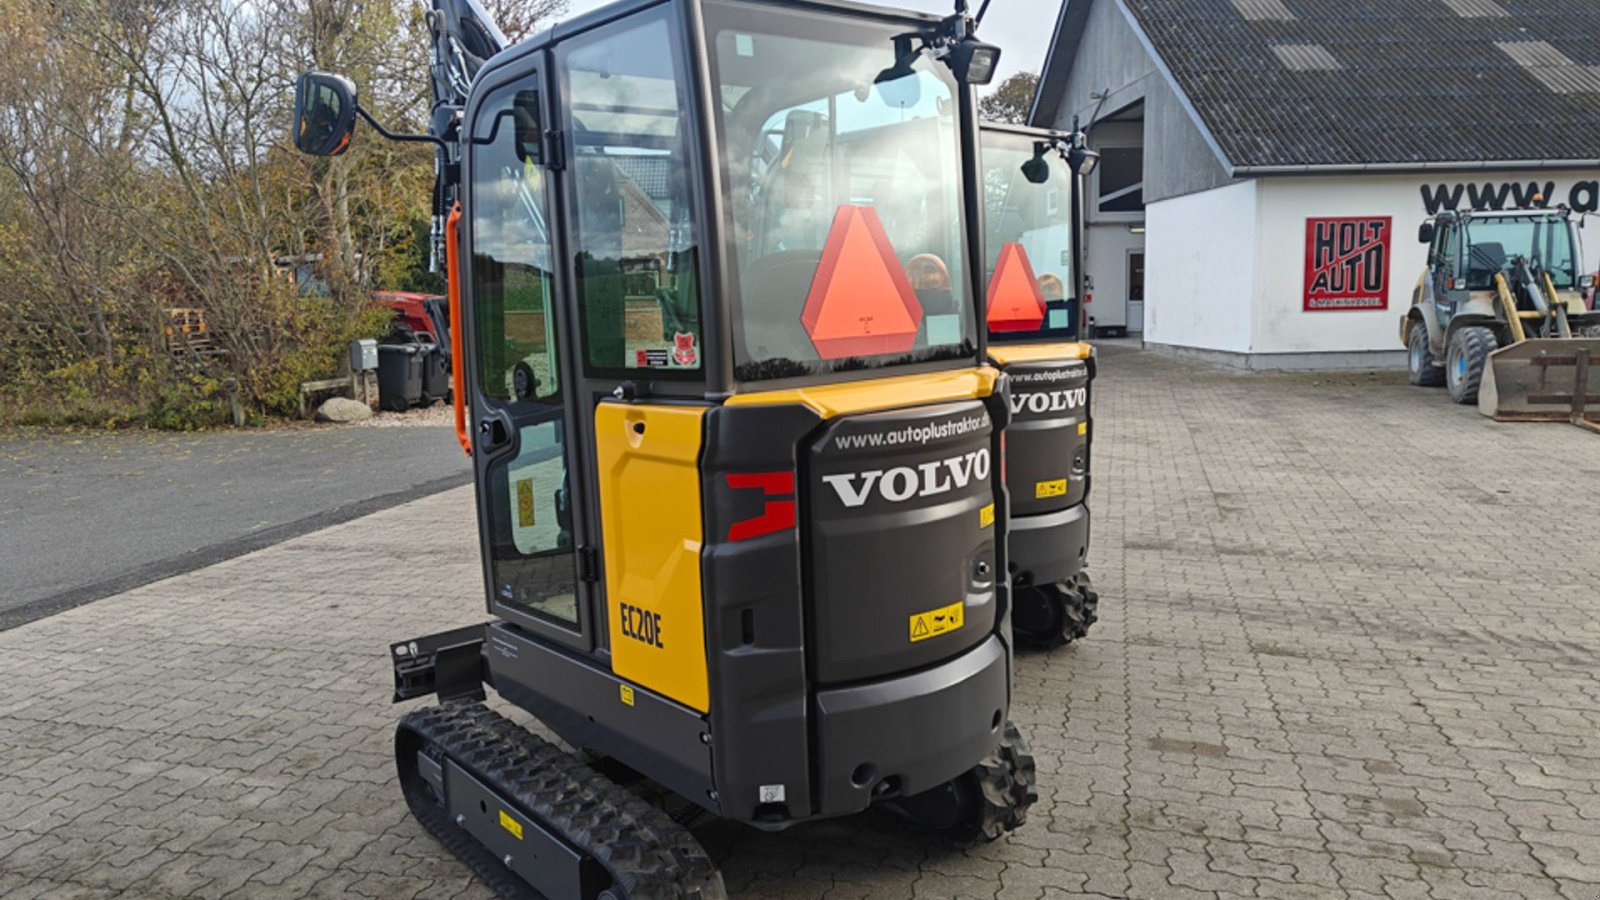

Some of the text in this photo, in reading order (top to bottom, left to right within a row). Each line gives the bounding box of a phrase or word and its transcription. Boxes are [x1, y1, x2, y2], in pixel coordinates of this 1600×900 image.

[1309, 243, 1384, 293] AUTO
[1315, 222, 1384, 270] HOLT
[1010, 387, 1086, 413] VOLVO
[822, 448, 990, 507] VOLVO
[620, 602, 664, 649] EC20E
